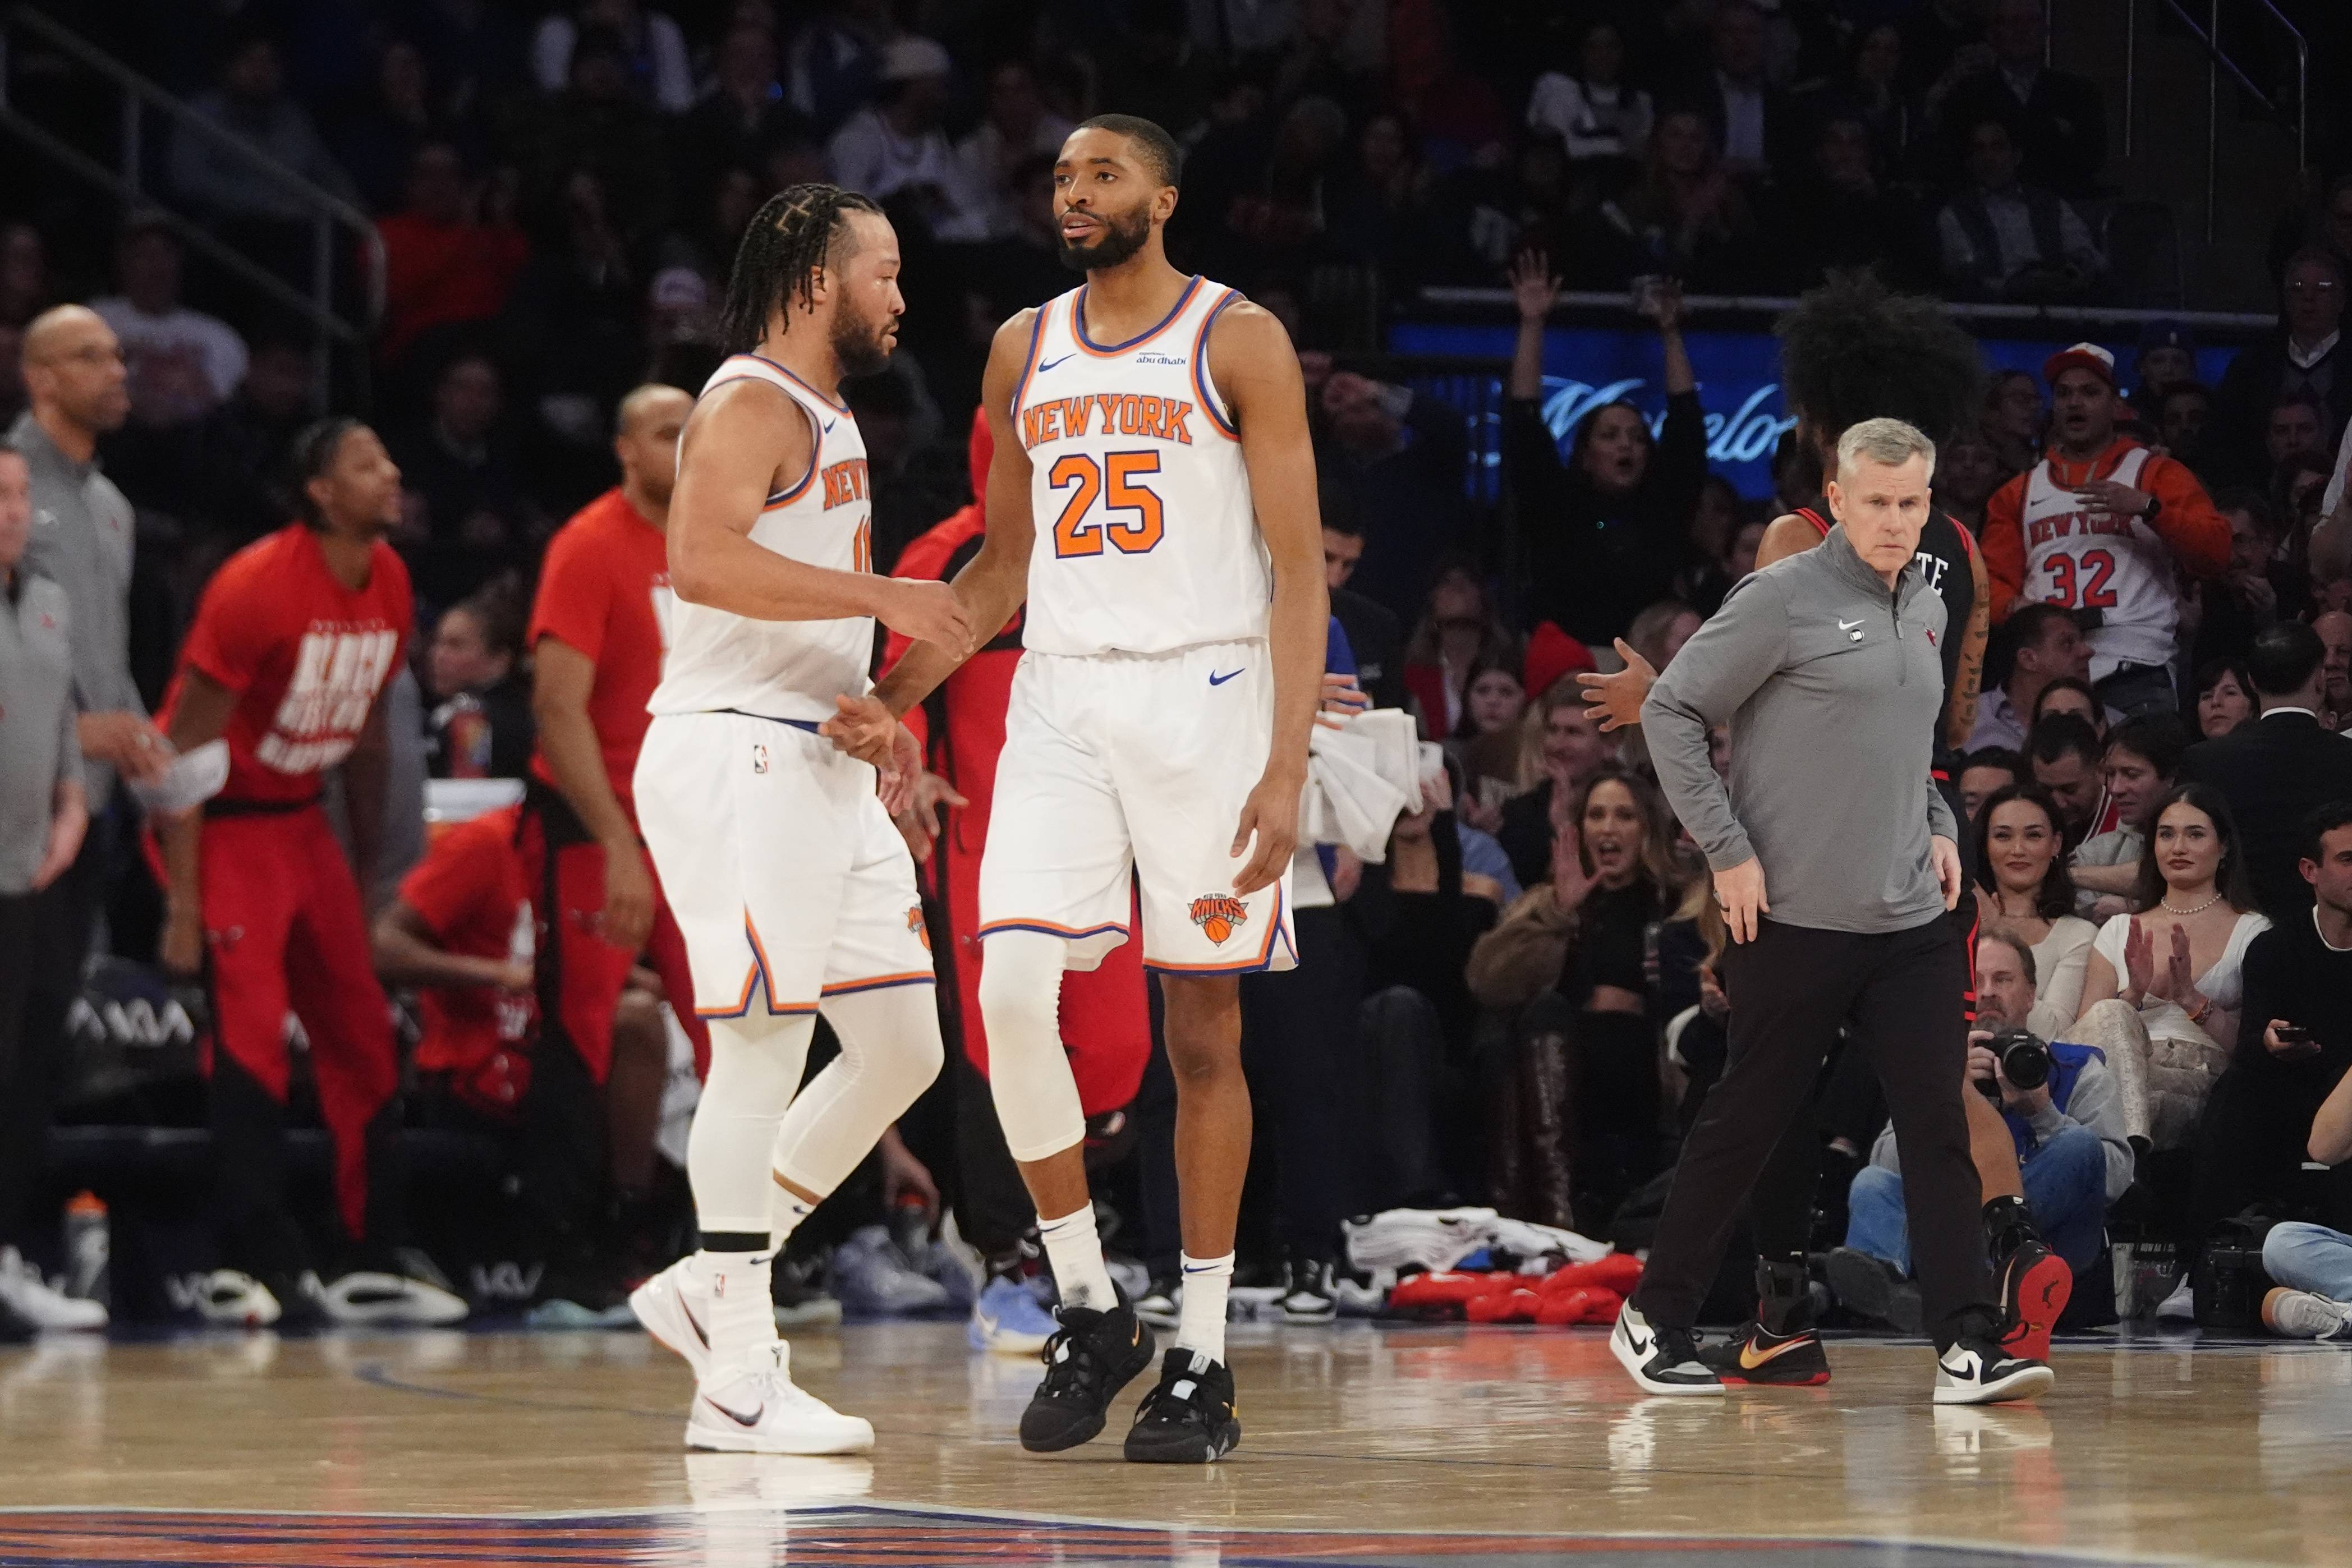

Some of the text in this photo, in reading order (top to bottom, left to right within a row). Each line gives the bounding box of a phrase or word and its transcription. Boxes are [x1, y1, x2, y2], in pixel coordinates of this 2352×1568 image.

[1023, 394, 1192, 449] NEW YORK
[1049, 449, 1165, 559] 25
[2043, 548, 2117, 609] 32
[1191, 898, 1248, 922] KNICKS
